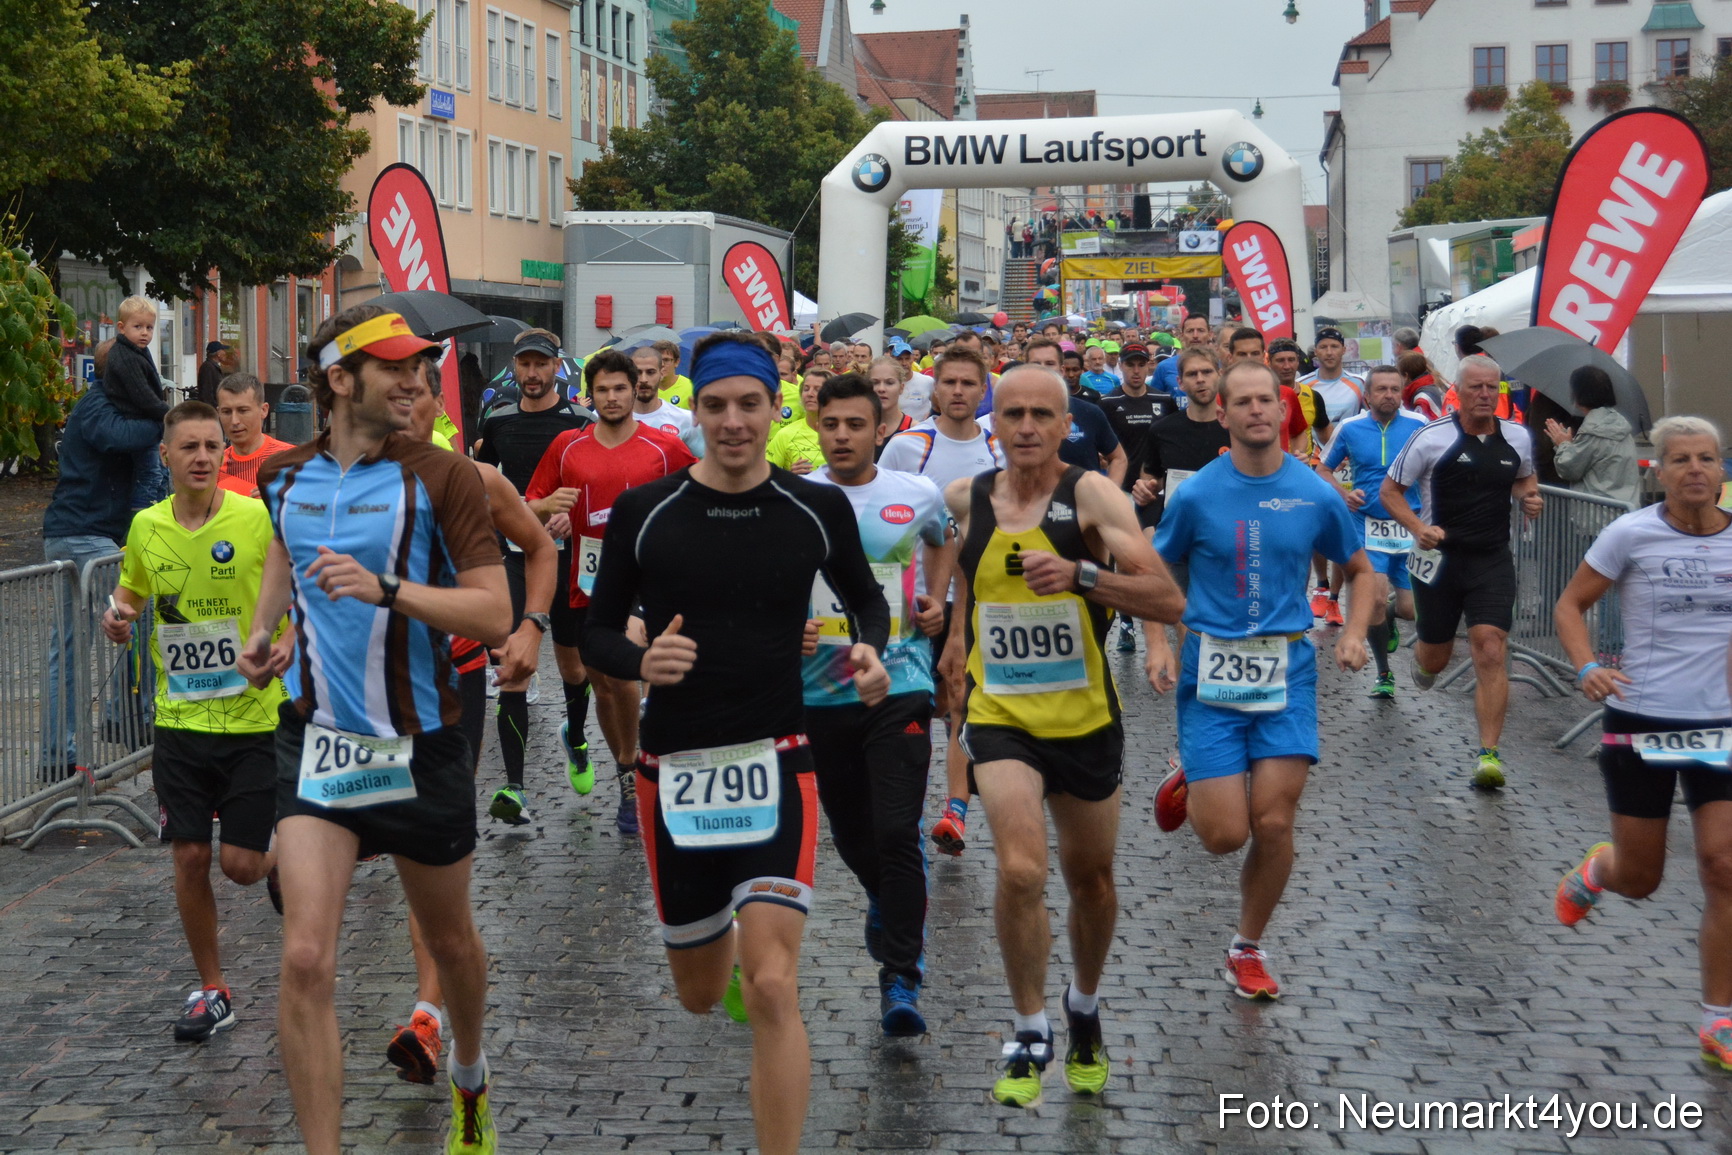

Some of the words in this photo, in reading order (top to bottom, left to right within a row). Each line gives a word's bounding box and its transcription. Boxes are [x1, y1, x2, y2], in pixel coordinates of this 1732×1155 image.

[904, 134, 1009, 166] BMW
[1019, 128, 1208, 167] Laufsport
[1549, 141, 1684, 346] REWE
[1124, 261, 1161, 275] ZIEL
[706, 506, 760, 519] uhlsport
[884, 505, 912, 520] Hervis
[1248, 520, 1260, 553] SWIM
[1370, 521, 1409, 538] 2610
[1377, 539, 1402, 548] Michael
[1406, 551, 1434, 579] 012
[1248, 572, 1260, 599] BIKE
[187, 599, 204, 608] THE
[206, 598, 229, 608] NEXT
[196, 607, 212, 616] 100
[214, 606, 242, 616] YEARS
[1018, 603, 1069, 618] BOCK
[1248, 601, 1260, 617] 90
[189, 621, 231, 635] BOCK
[989, 623, 1074, 659] 3096
[167, 638, 236, 671] 2826
[1208, 652, 1280, 683] 2357
[187, 675, 222, 688] Pascal
[1214, 688, 1268, 700] Johannes
[709, 743, 768, 764] BOCK
[321, 774, 392, 798] Sebastian
[673, 762, 769, 805] 2790
[692, 815, 752, 831] Thomas
